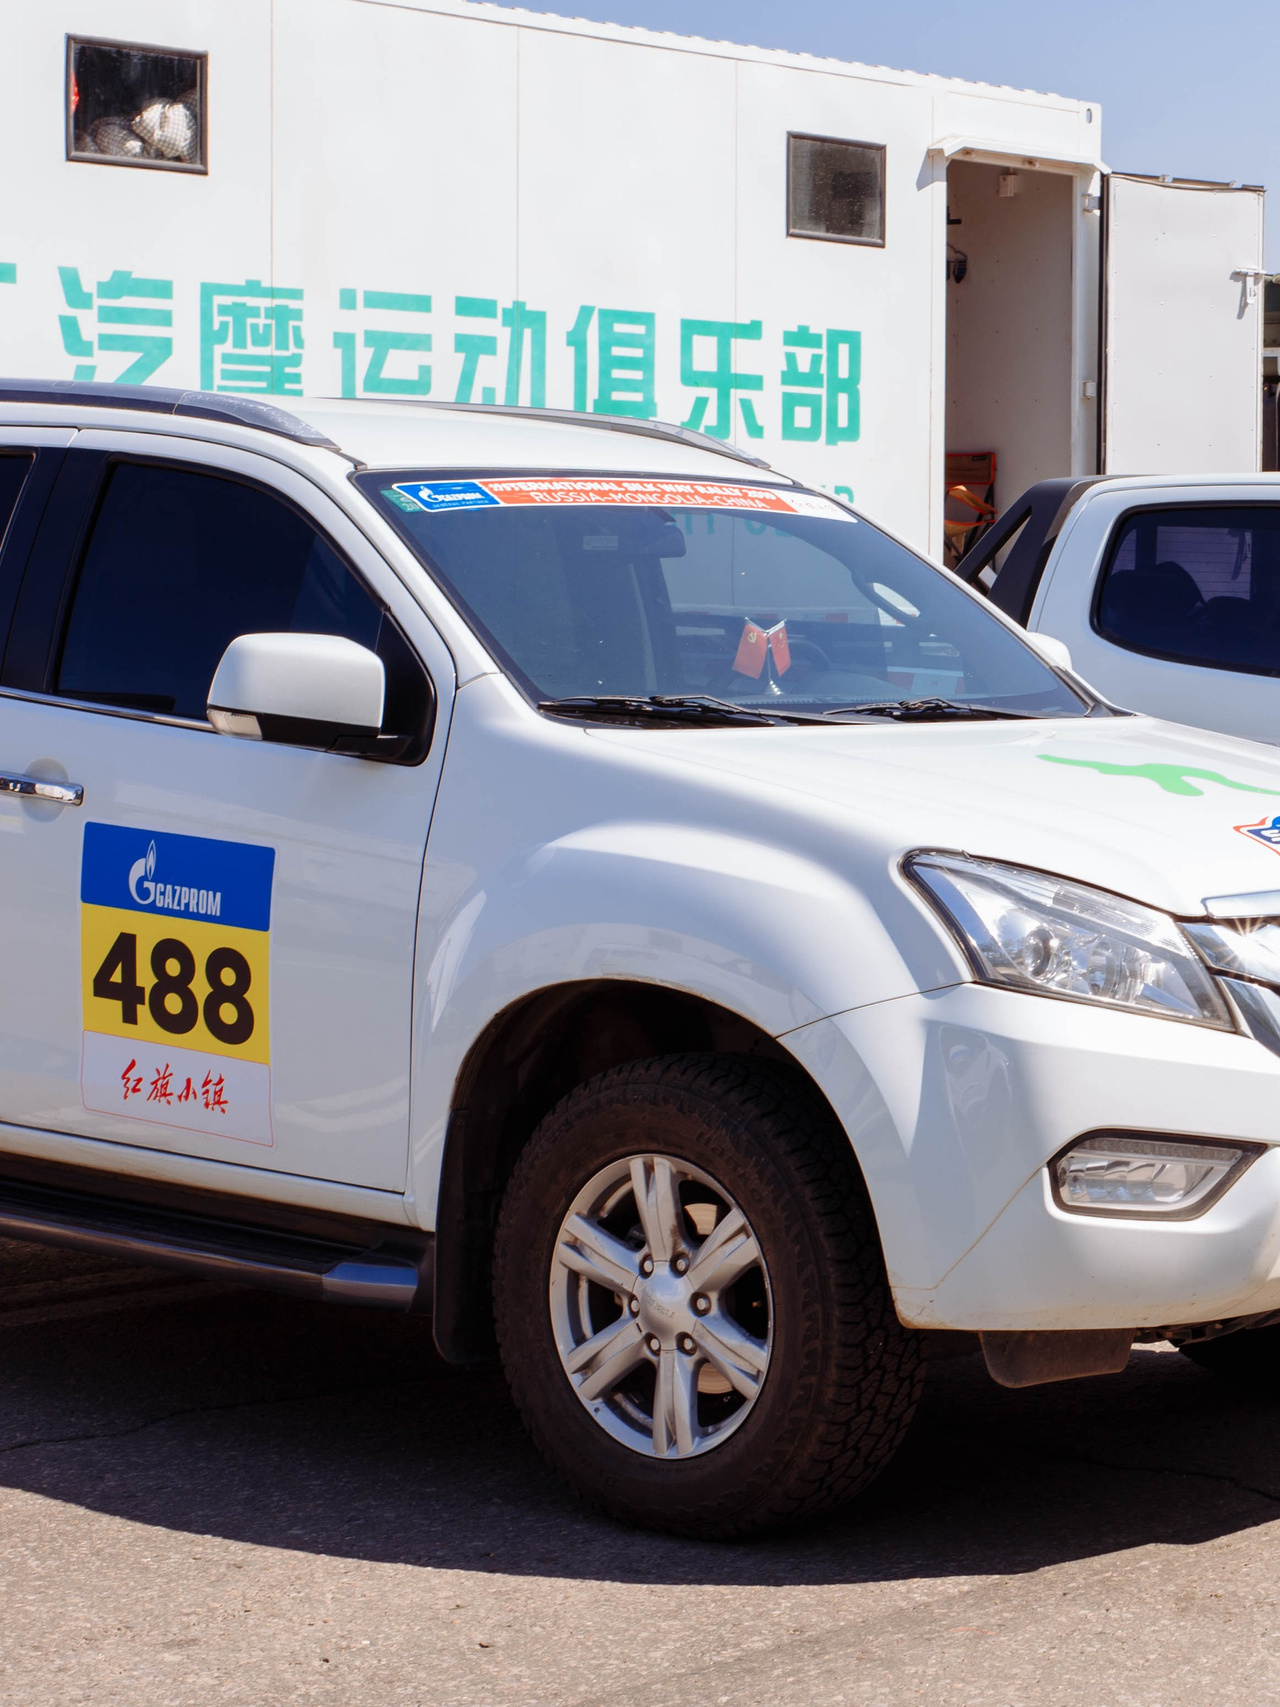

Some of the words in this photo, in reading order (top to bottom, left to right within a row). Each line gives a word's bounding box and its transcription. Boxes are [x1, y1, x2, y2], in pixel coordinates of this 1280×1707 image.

[0, 262, 862, 446] 汽摩运动俱乐部
[155, 883, 222, 917] GAZPROM
[93, 931, 255, 1045] 488
[120, 1058, 229, 1114] 红旗小镇
